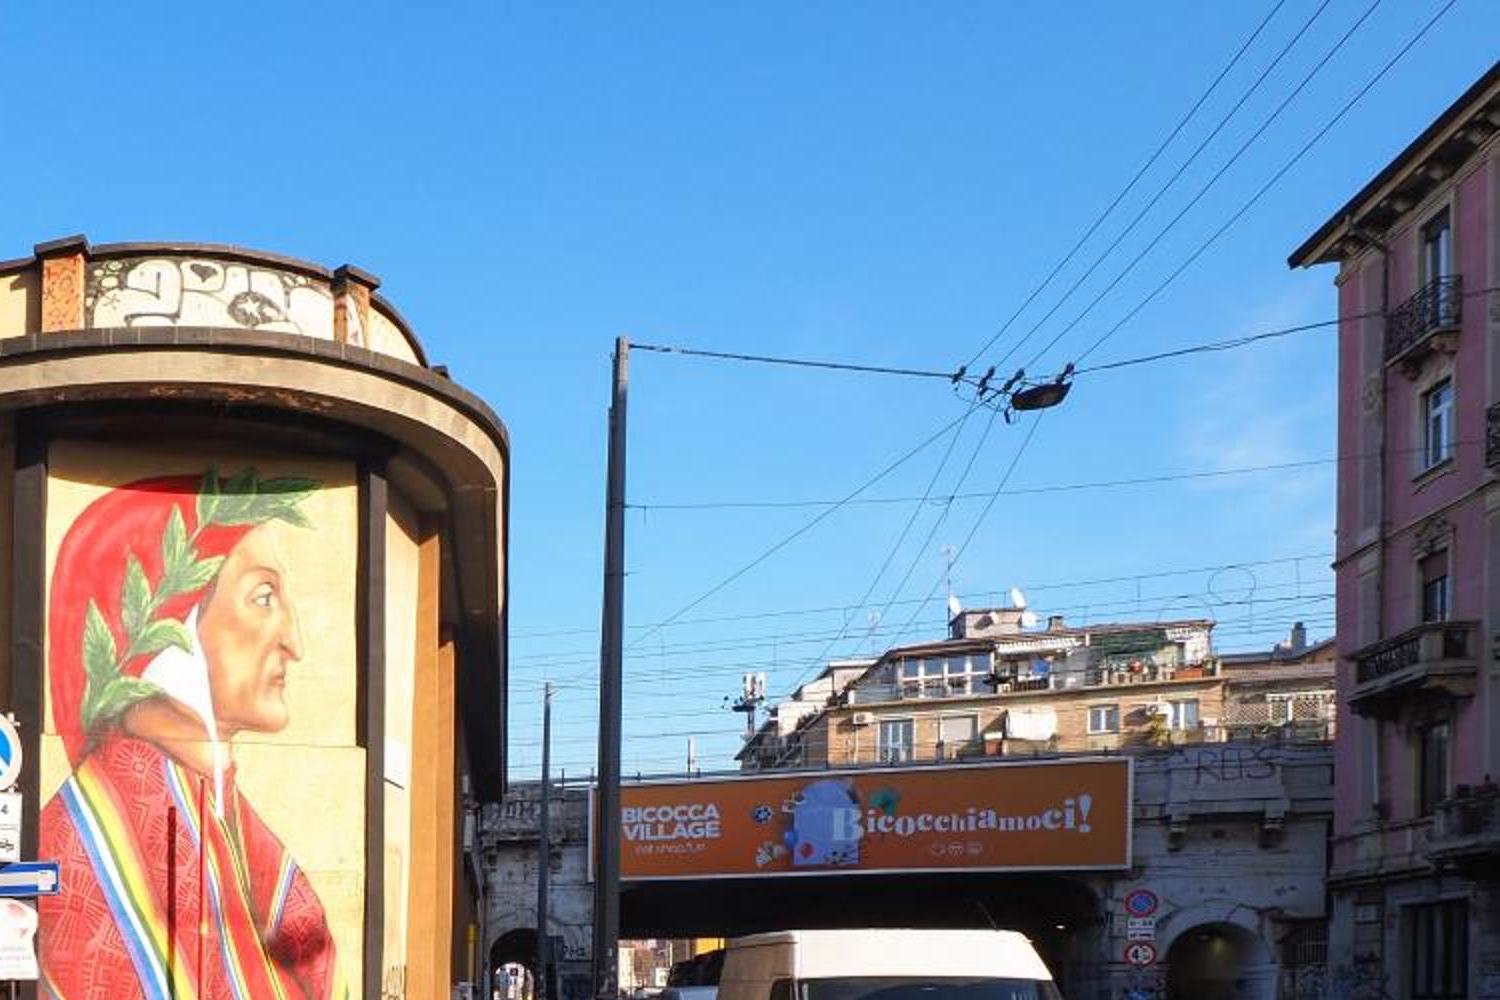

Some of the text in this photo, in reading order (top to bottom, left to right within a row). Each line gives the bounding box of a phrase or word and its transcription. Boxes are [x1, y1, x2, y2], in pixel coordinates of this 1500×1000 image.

[621, 803, 719, 823] BICOCCA
[832, 793, 1093, 842] Bicocchiamoci!
[623, 820, 721, 841] VILLAGE
